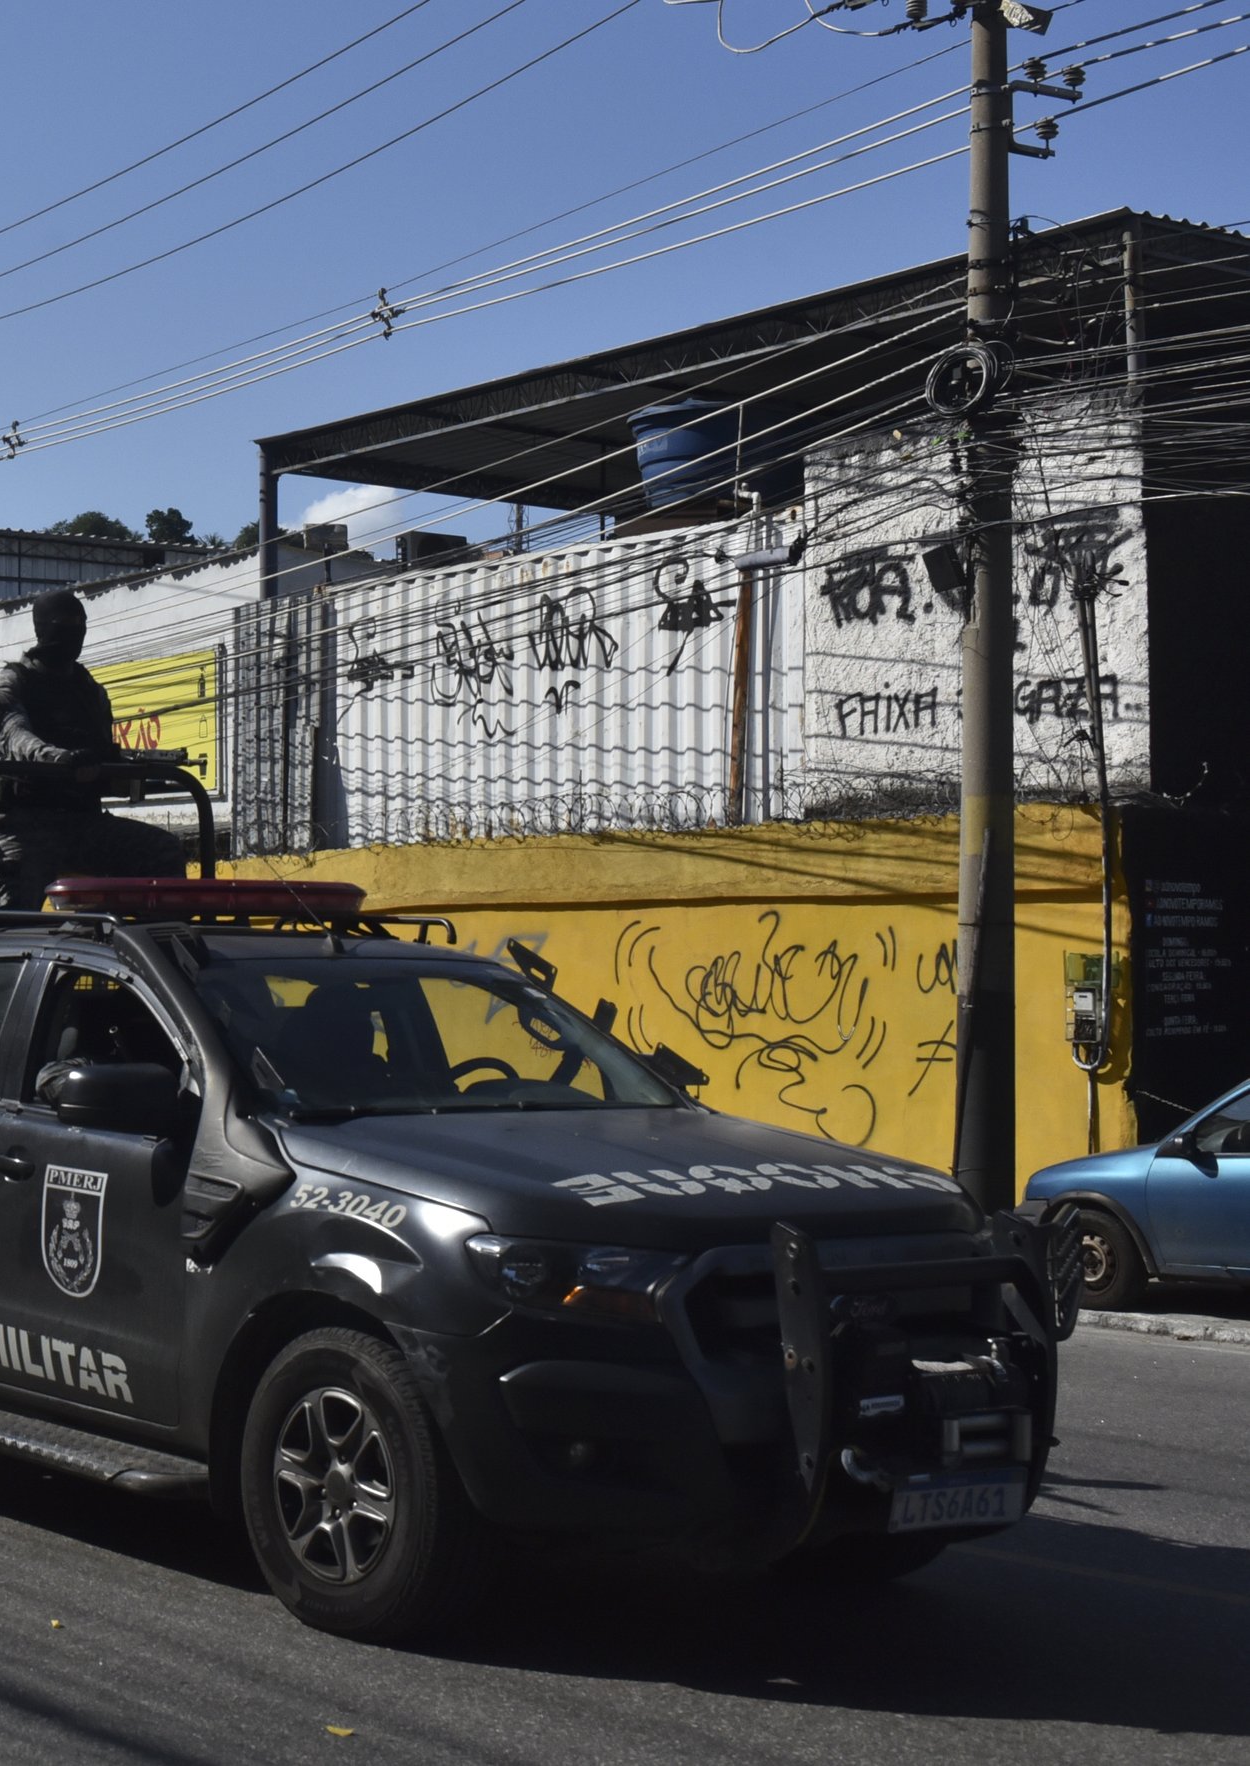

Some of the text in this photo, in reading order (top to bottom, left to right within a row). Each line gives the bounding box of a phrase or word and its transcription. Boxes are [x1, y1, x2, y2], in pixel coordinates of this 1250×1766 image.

[49, 1169, 103, 1191] PMERJ
[290, 1184, 406, 1228] 52-3040
[902, 1486, 1006, 1525] LTS6A61
